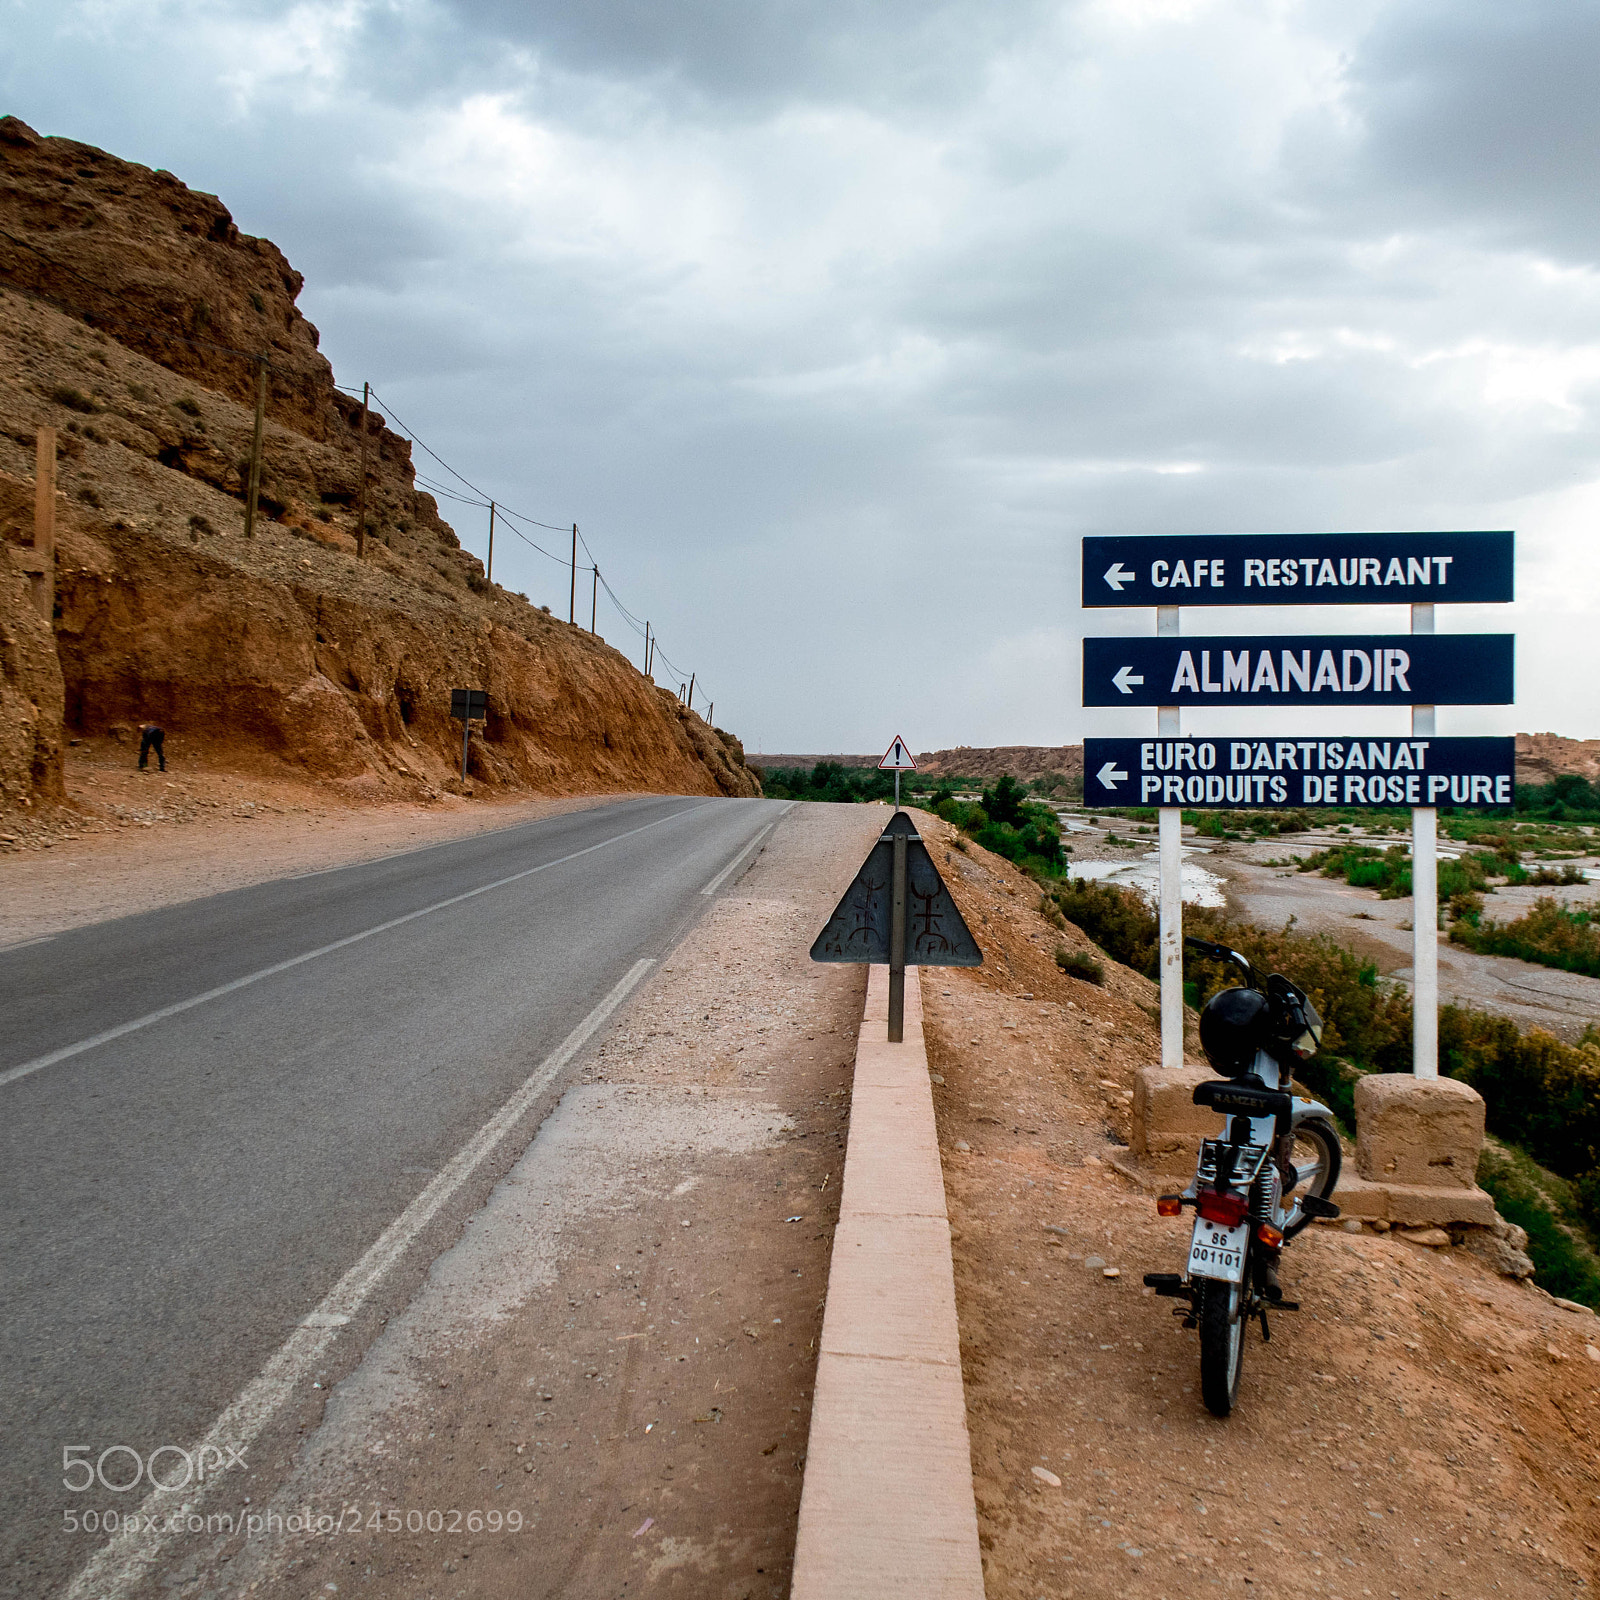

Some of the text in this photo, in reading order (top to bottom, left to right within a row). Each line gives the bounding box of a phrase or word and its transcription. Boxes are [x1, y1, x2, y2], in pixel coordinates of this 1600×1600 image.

[1151, 556, 1453, 588] CAFE RESTAURANT
[1171, 649, 1411, 693] ALMANADIR
[1141, 741, 1430, 771] EURO D'ARTISANAT
[1141, 775, 1511, 803] PRODUITS DE ROSE PURE
[1213, 1092, 1267, 1108] RAMZEY
[1211, 1232, 1228, 1246] 86
[1192, 1247, 1241, 1268] 001101
